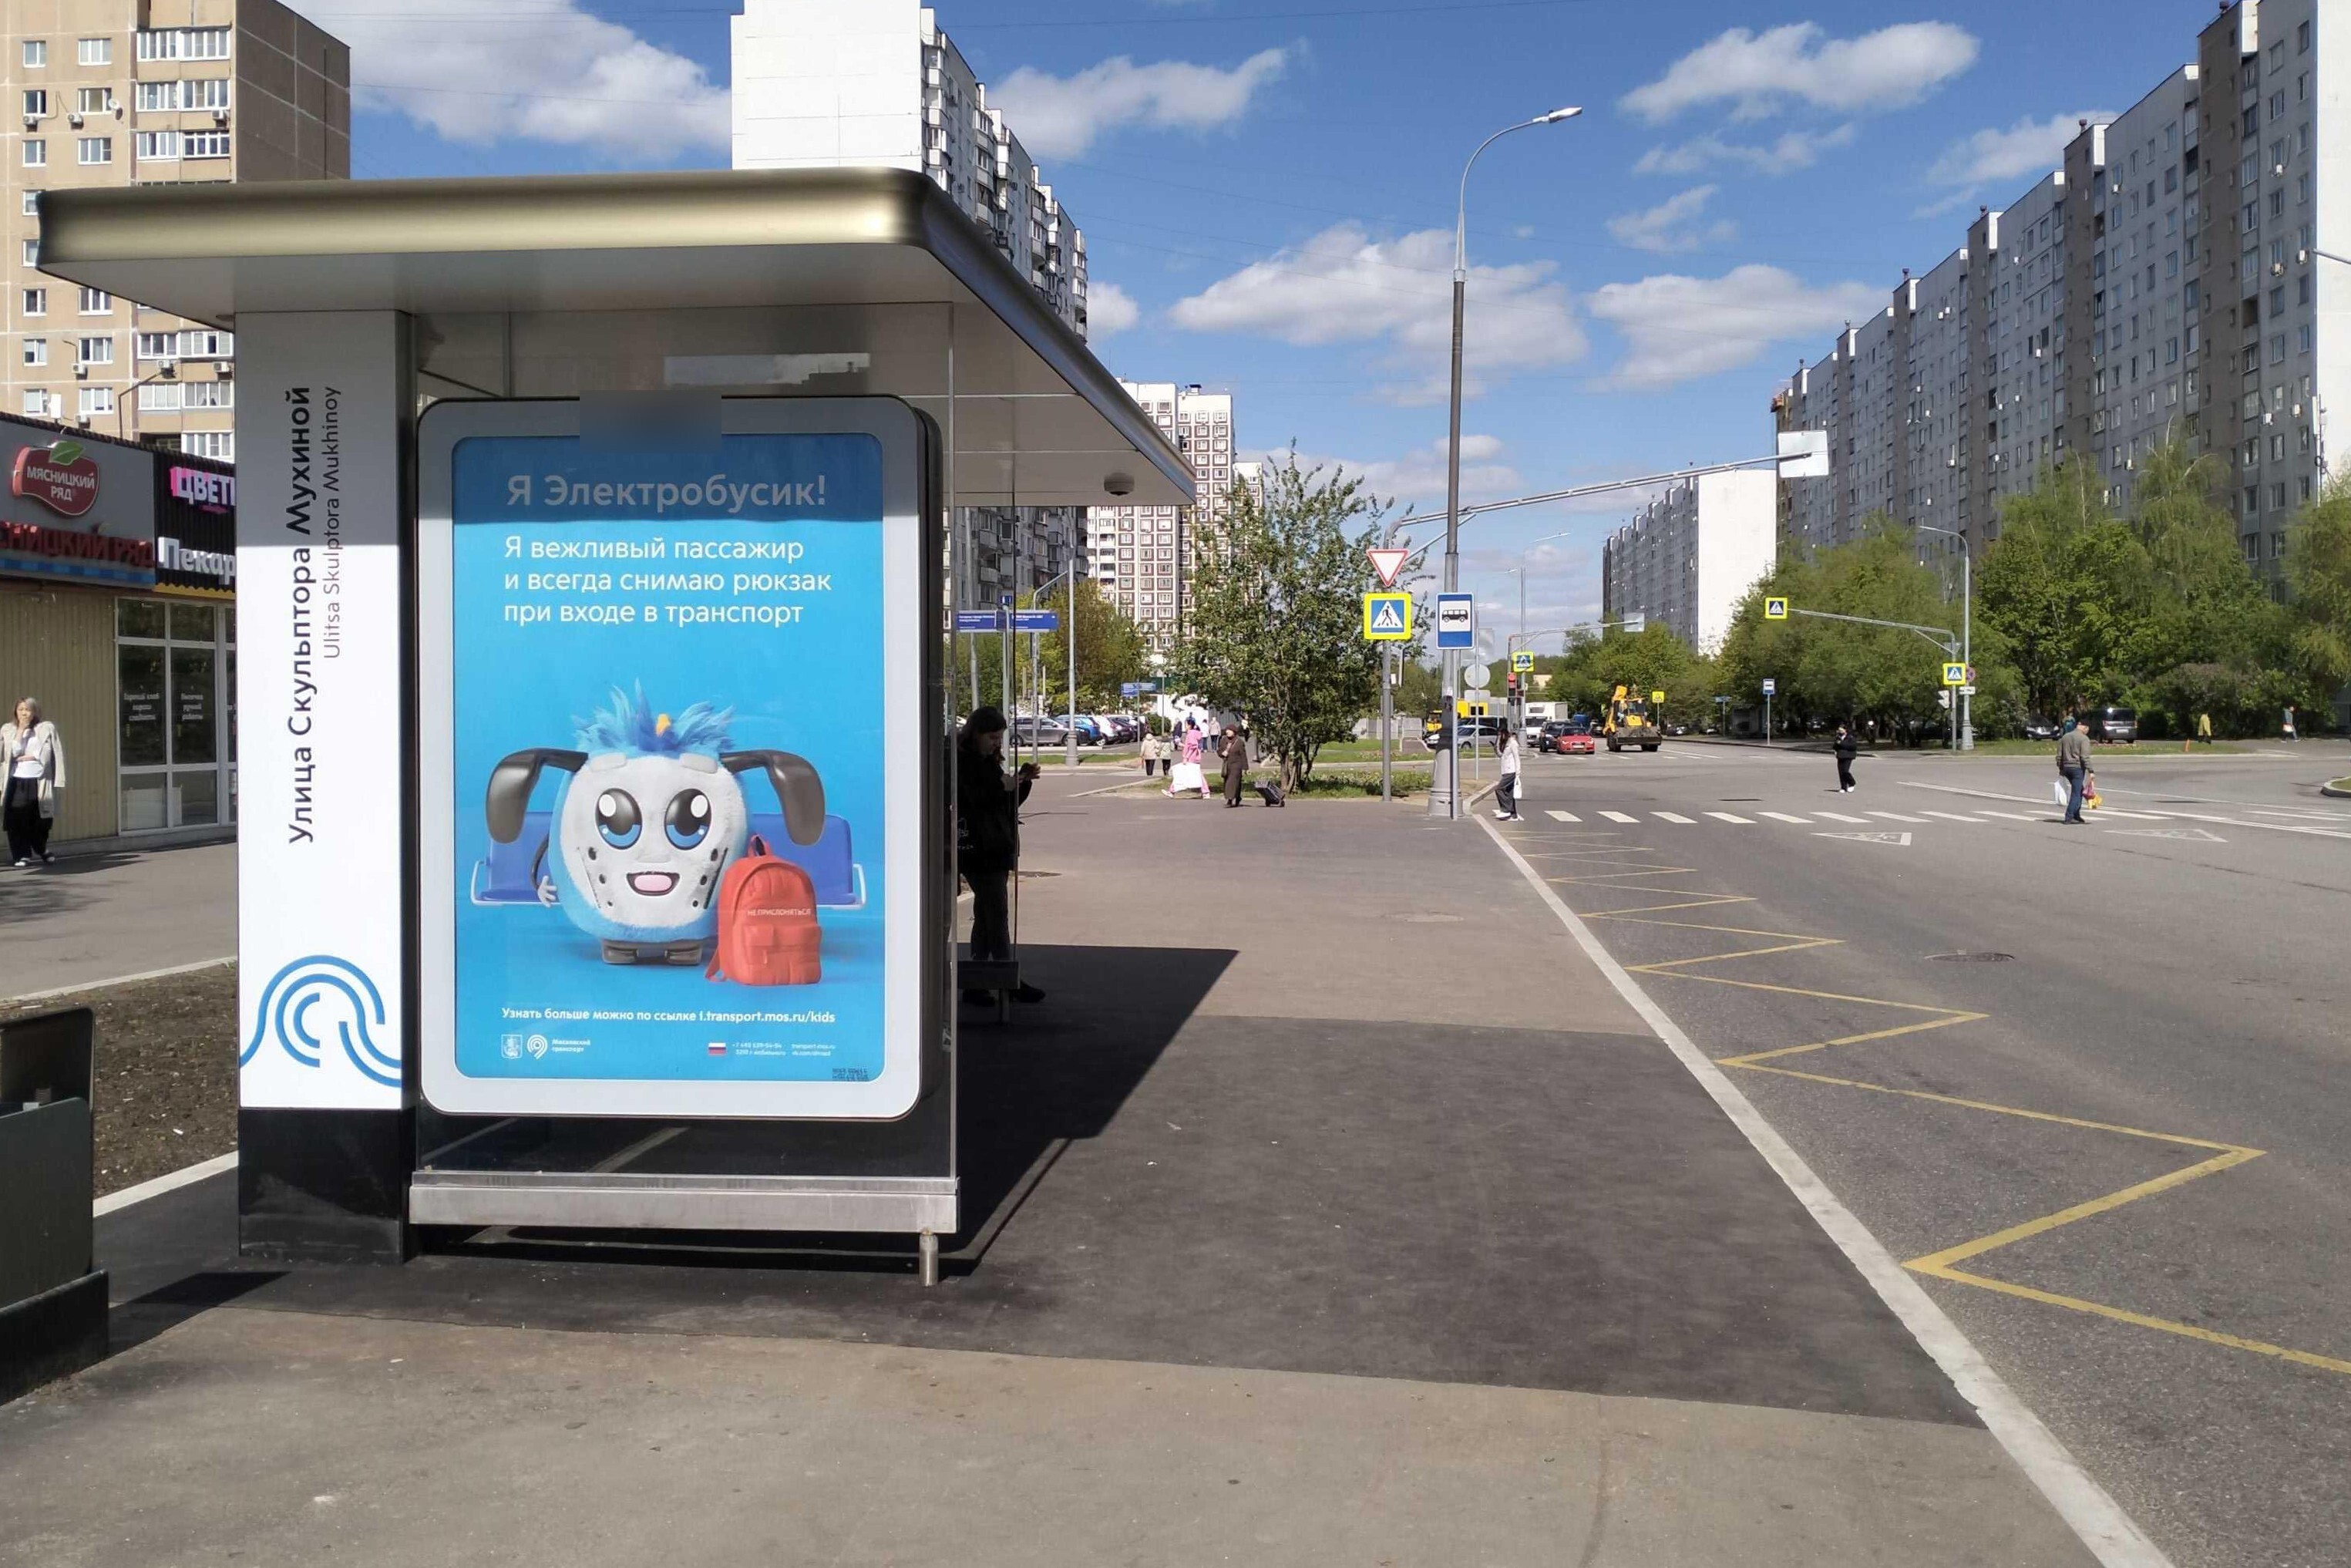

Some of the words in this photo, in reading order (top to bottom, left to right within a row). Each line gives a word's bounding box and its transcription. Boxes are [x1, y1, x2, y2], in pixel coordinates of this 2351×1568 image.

[321, 386, 341, 493] Mukhinoy
[26, 466, 96, 490] МЯСНИЦКИЙ
[284, 387, 317, 536] Мухиной
[50, 486, 73, 502] РЯД
[506, 475, 531, 506] Я
[543, 473, 826, 513] Электробусик!
[111, 537, 154, 568] РЯД
[322, 498, 343, 595] Skulptora
[505, 537, 522, 558] Я
[531, 537, 665, 559] вежливый
[674, 541, 804, 564] пассажир
[505, 574, 518, 590] и
[528, 574, 612, 593] всегда
[620, 573, 725, 591] снимаю
[734, 574, 832, 594] рюкзак
[323, 601, 341, 659] Ulitsa
[505, 605, 551, 626] при
[560, 605, 636, 625] входе
[644, 606, 658, 622] в
[665, 606, 803, 628] транспорт
[288, 547, 318, 735] Скульптора
[288, 746, 316, 843] Улица
[502, 1008, 542, 1018] Узнать
[544, 1008, 590, 1020] больше
[593, 1011, 634, 1020] можно
[637, 1012, 652, 1021] по
[699, 1010, 836, 1024] i.transport.mos.ru/kids
